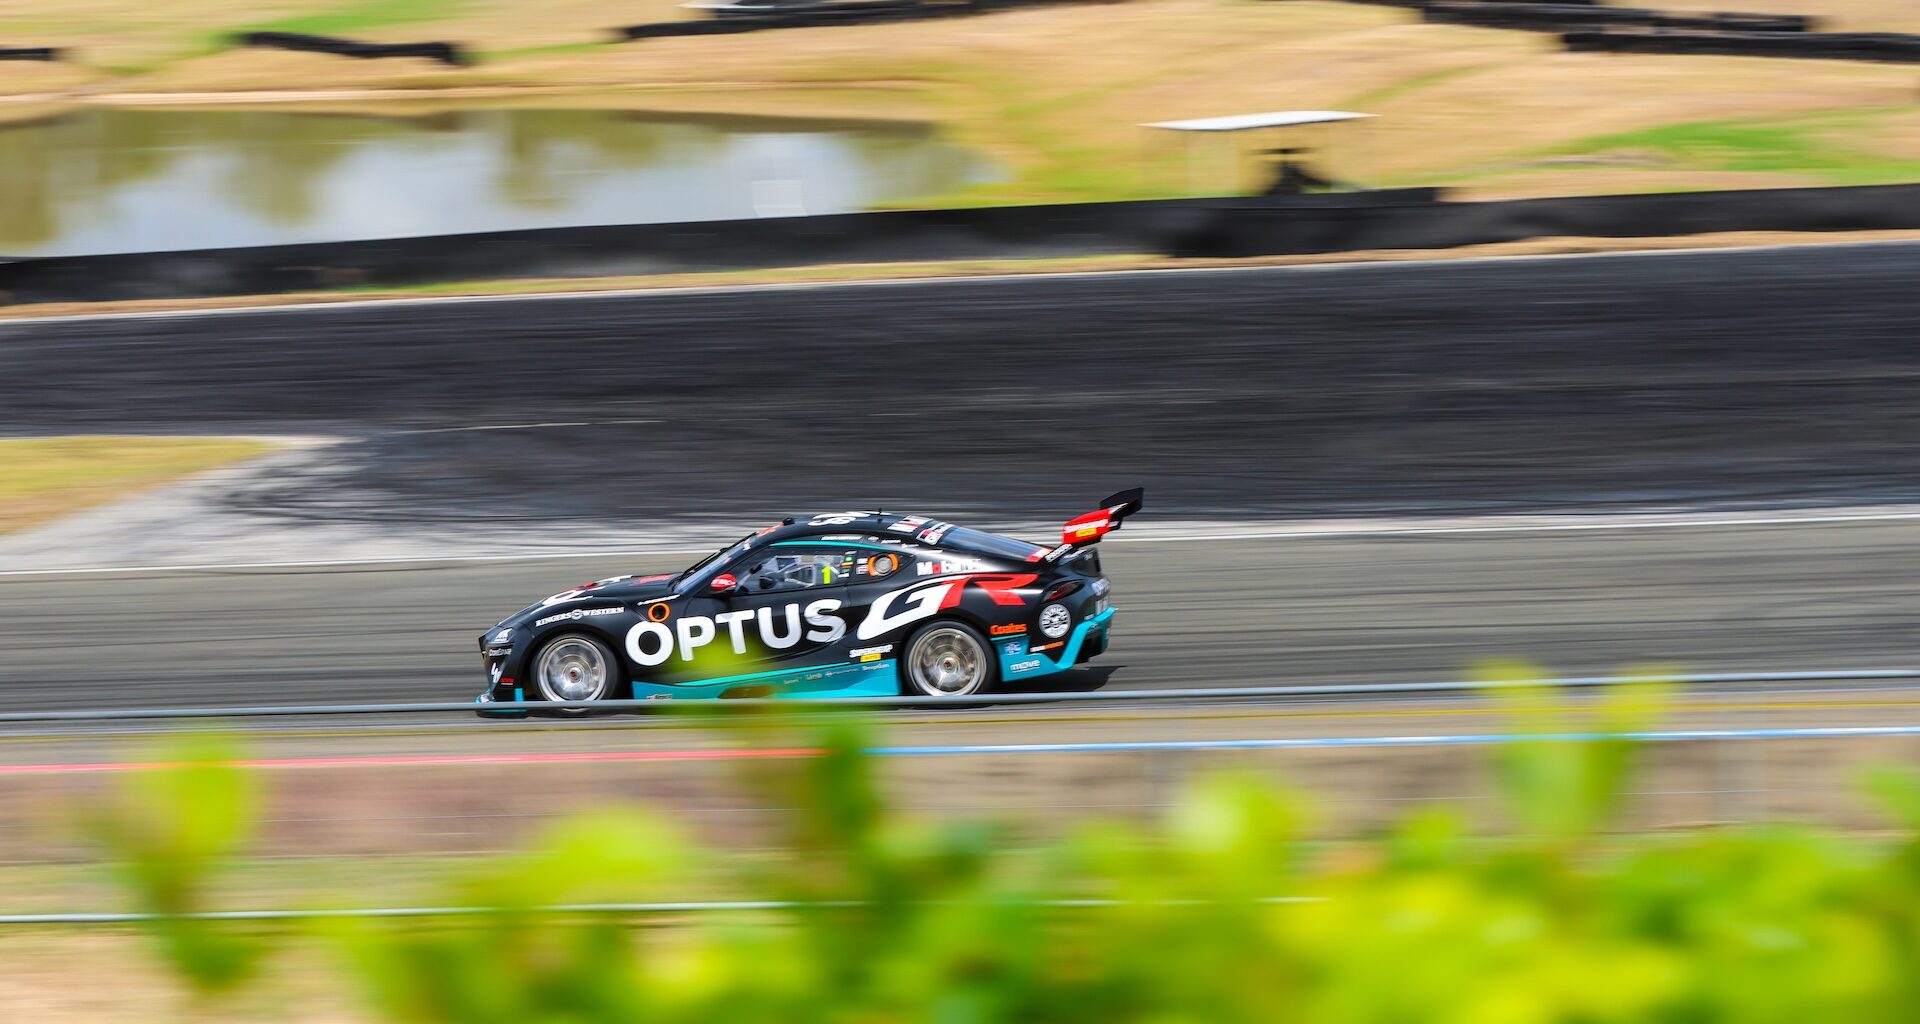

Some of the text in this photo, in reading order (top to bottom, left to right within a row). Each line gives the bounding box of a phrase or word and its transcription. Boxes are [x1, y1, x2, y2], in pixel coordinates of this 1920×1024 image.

[821, 565, 831, 585] 1
[536, 607, 625, 627] RINGERS WESTERN
[625, 598, 847, 667] OPTUS
[1010, 659, 1041, 671] move
